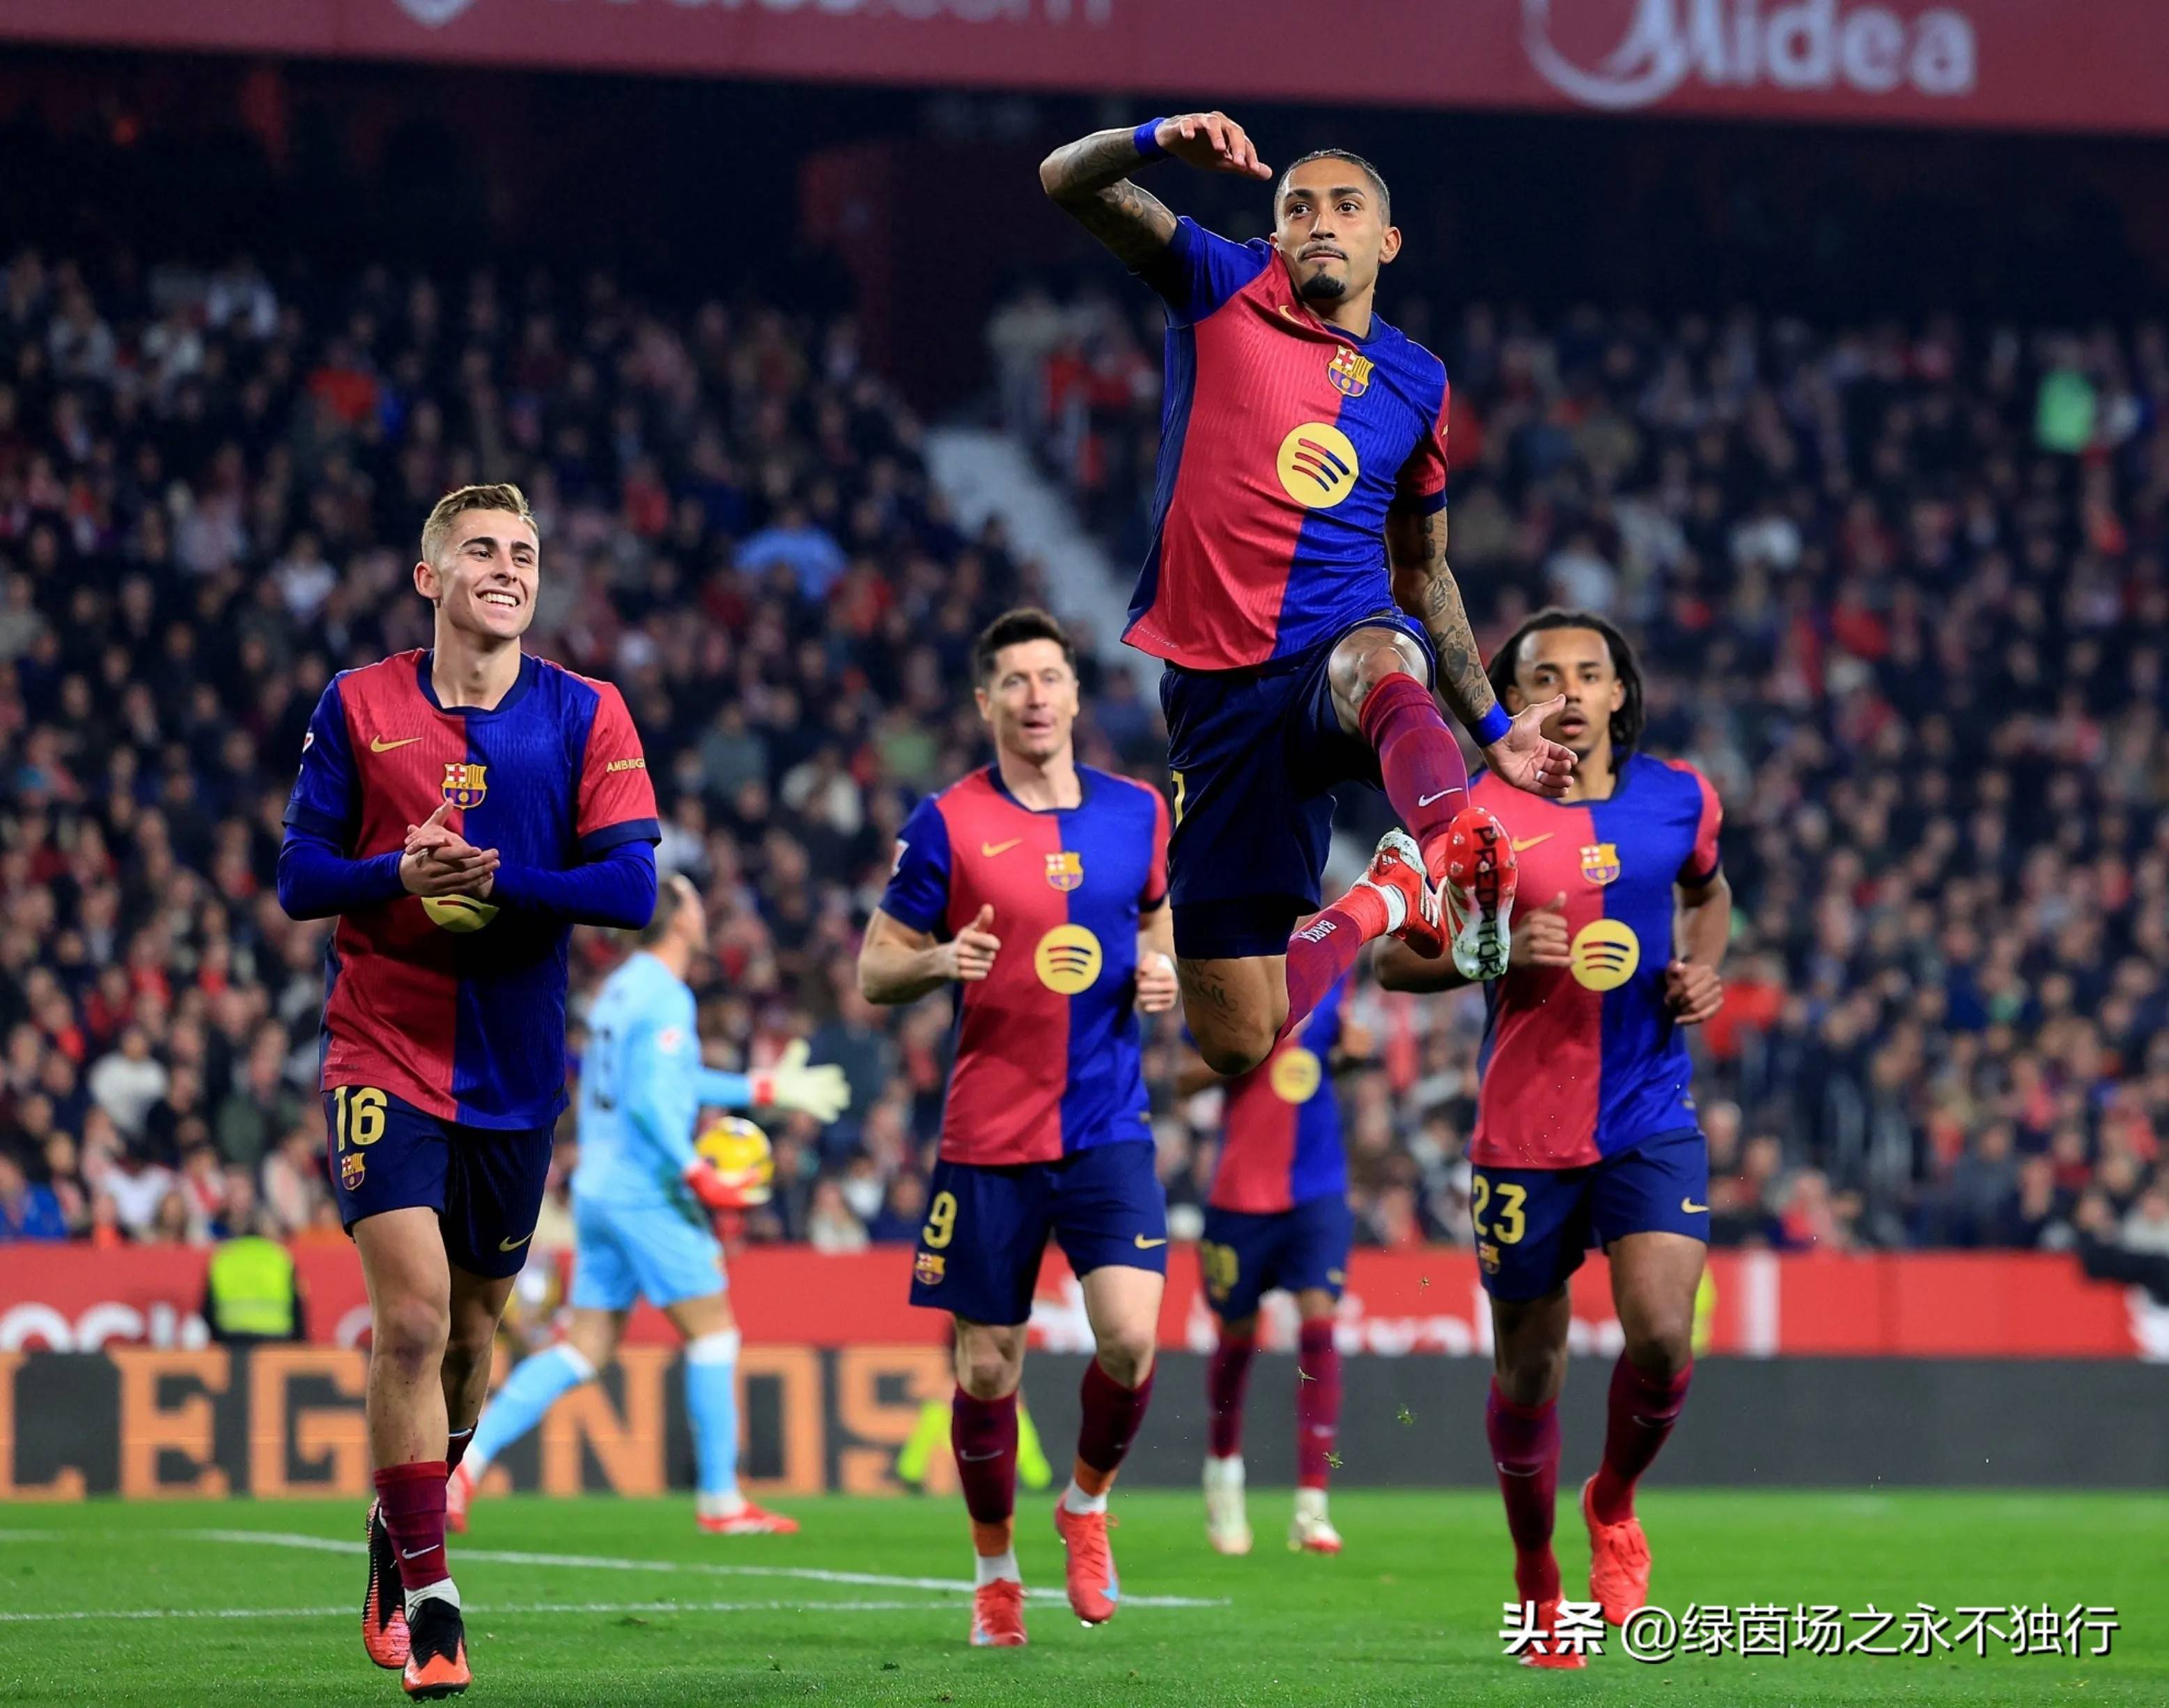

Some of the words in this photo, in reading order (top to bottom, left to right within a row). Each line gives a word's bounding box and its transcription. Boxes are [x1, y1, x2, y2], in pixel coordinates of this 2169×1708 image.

[1473, 826, 1501, 976] PREDATOR
[334, 1086, 388, 1152] 16
[922, 1190, 958, 1249] 9
[1473, 1174, 1527, 1244] 23
[0, 1346, 958, 1500] LEGNDS
